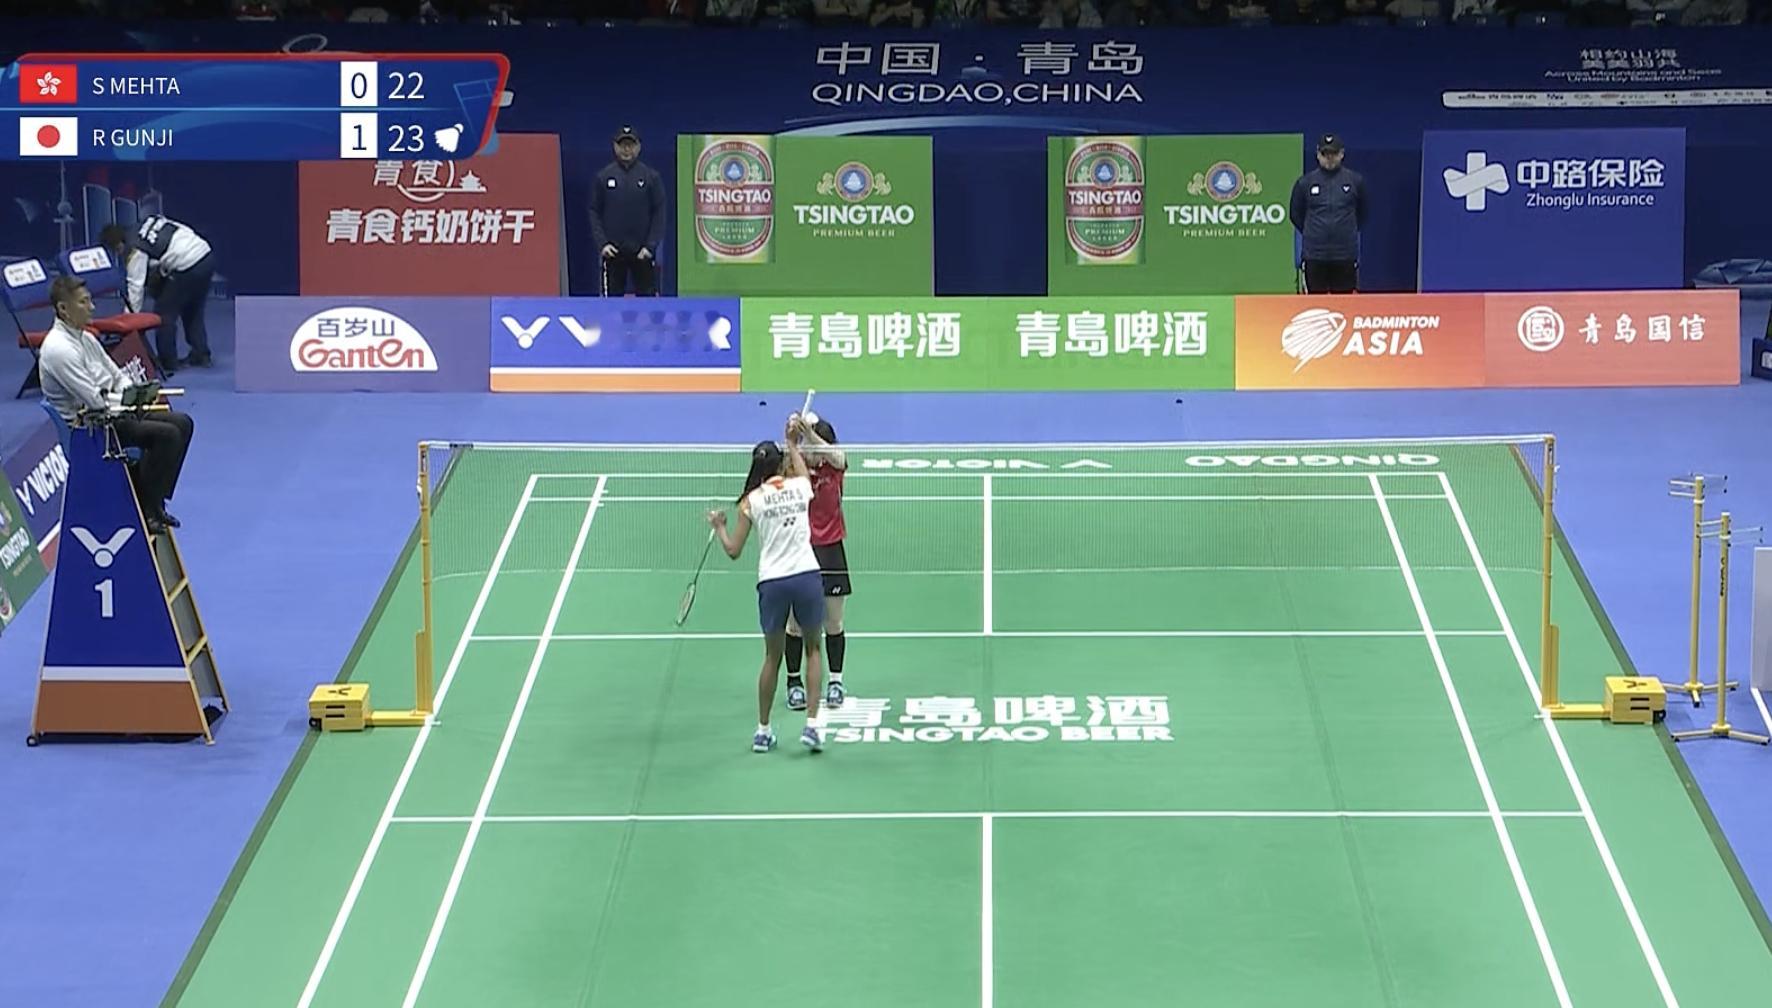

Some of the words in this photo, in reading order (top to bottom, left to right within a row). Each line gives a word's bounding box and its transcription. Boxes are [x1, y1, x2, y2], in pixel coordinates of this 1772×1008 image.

[1517, 158, 1665, 190] 中路保险
[697, 188, 772, 204] TSINGTAO
[1067, 189, 1143, 205] TSINGTAO
[1526, 193, 1585, 210] Zhonglu
[1587, 193, 1654, 207] Insurance
[792, 204, 915, 226] TSINGTAO
[1163, 204, 1287, 226] TSINGTAO
[326, 208, 536, 245] 青食钙奶饼干
[812, 228, 865, 238] PREMIUM
[867, 228, 896, 238] BEER
[1183, 228, 1236, 238] PREMIUM
[1238, 228, 1267, 238] BEER
[316, 317, 396, 339] 百岁山
[1352, 315, 1440, 330] BADMINTON
[1577, 312, 1706, 345] 青岛国信
[1341, 333, 1425, 357] ASIA
[861, 457, 1050, 470] VICTOR
[1185, 453, 1441, 467] QINGDAO
[765, 491, 795, 504] MEHTA
[94, 579, 115, 618] 1
[1061, 726, 1175, 743] BEER
